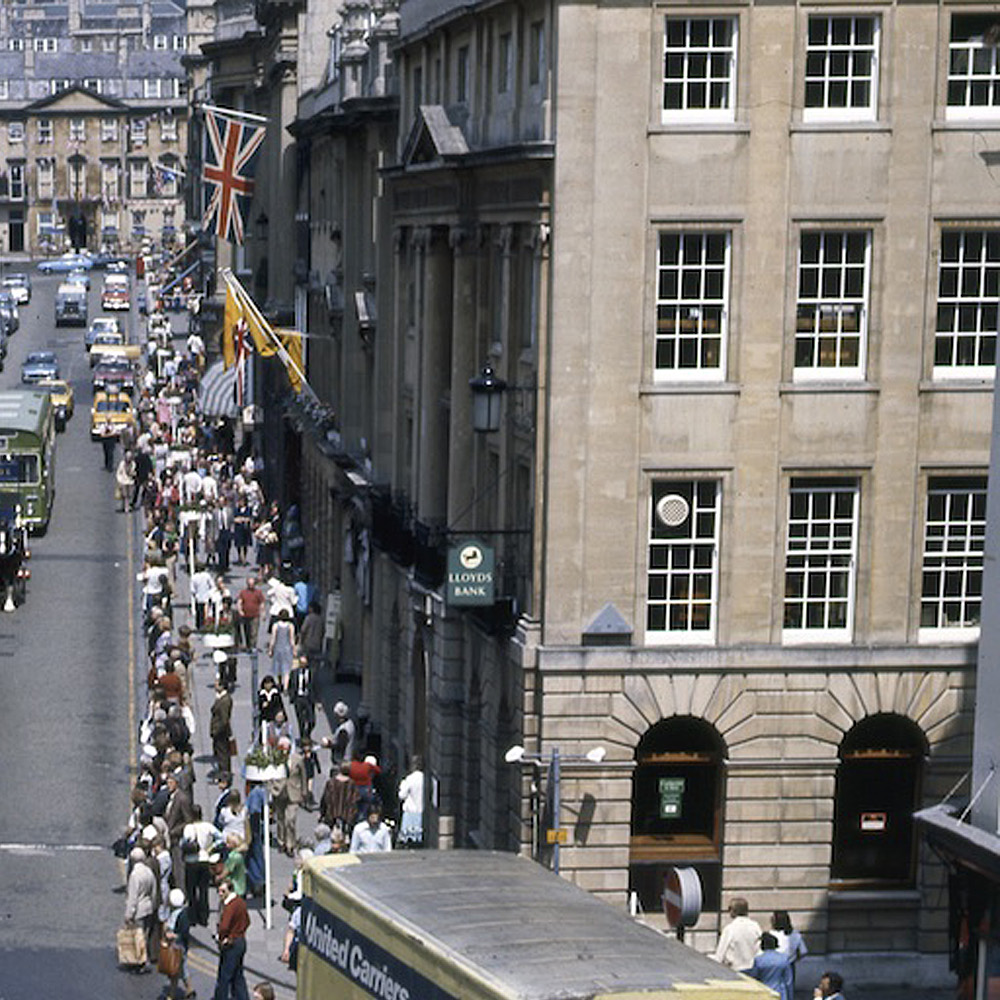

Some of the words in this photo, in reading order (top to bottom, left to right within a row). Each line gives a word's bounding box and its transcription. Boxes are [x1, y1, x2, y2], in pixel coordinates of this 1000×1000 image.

[449, 573, 492, 583] LLOYDS
[455, 587, 485, 597] BANK
[305, 912, 350, 969] United
